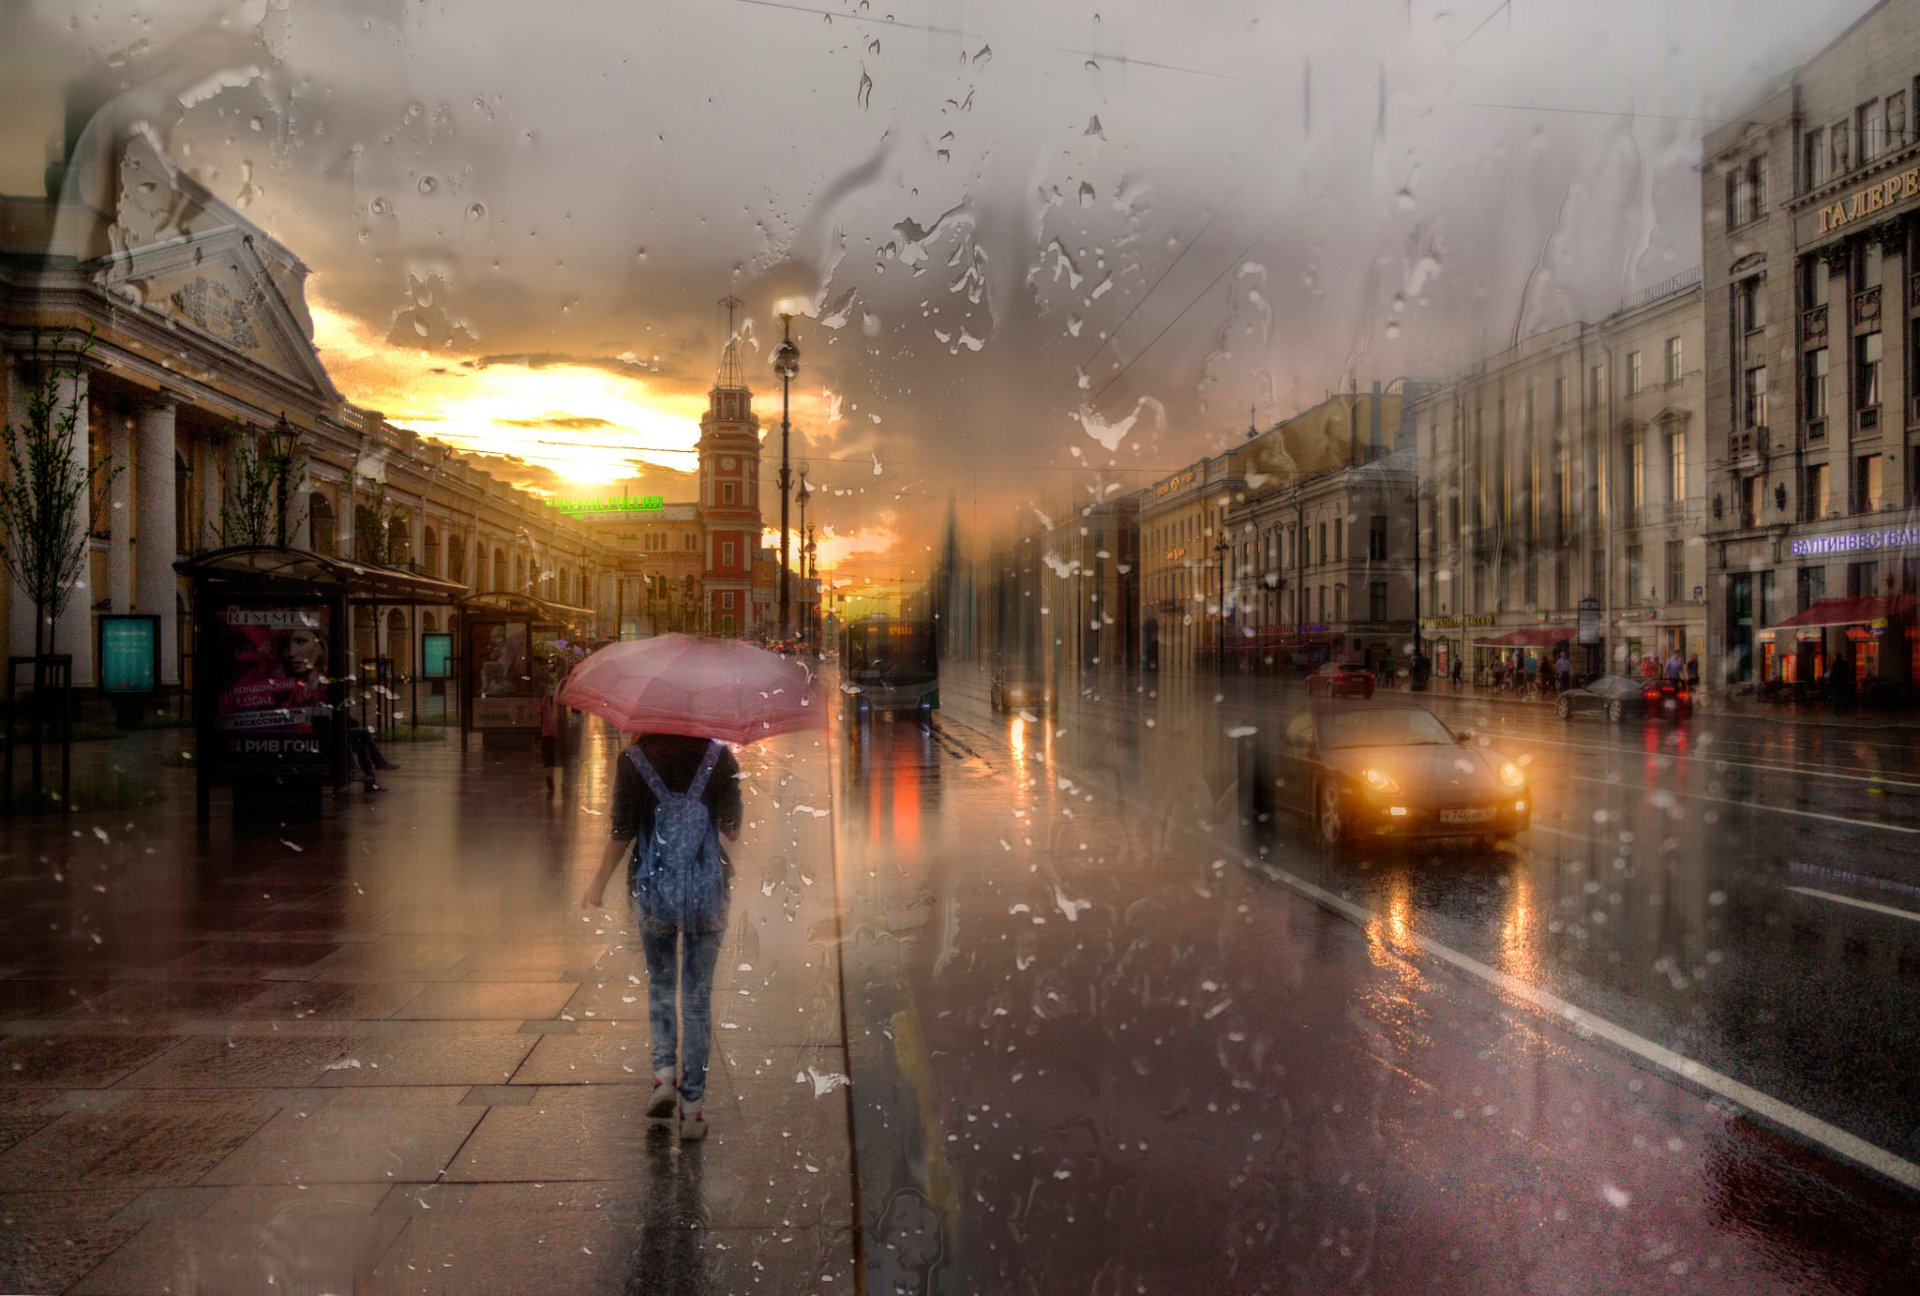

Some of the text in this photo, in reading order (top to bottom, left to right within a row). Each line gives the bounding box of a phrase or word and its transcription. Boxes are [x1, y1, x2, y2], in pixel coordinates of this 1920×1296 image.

[1818, 168, 1920, 233] ГАЛЕРЕ
[245, 739, 320, 753] РИВ ГОШ
